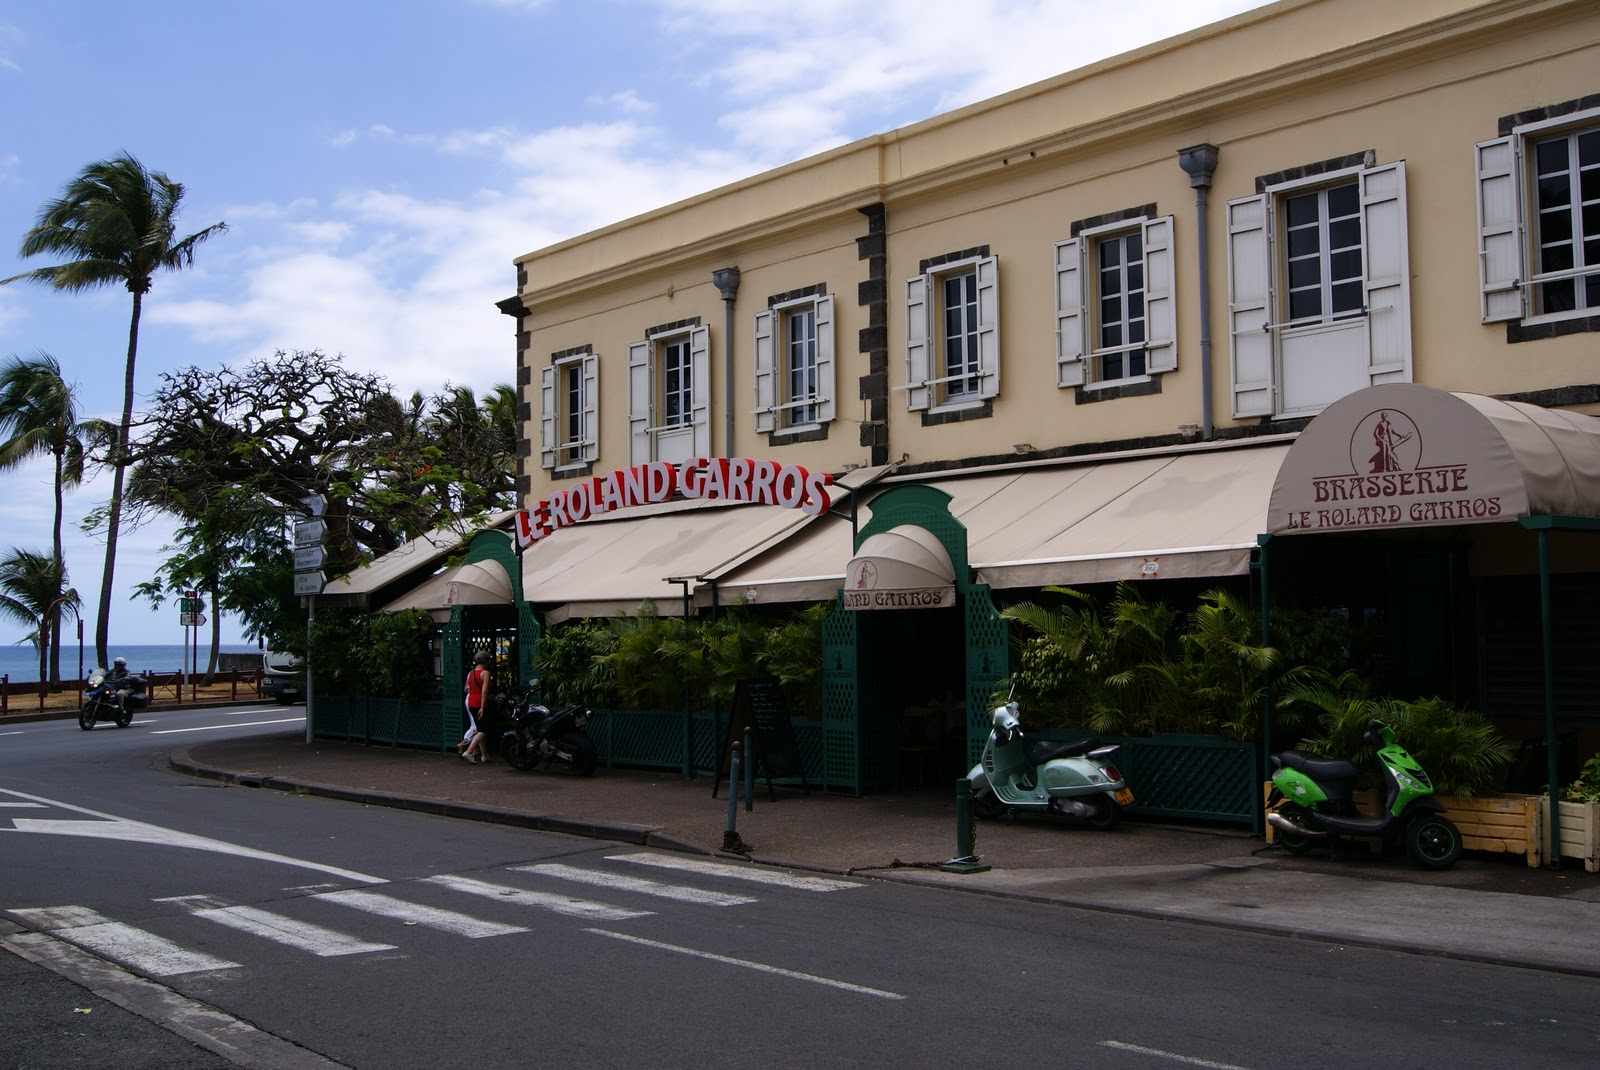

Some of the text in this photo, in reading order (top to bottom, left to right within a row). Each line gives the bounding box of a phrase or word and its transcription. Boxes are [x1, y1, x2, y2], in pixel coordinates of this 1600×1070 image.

[515, 457, 833, 548] LE ROLAND GARROS
[1312, 468, 1469, 503] BRASSERIE
[1287, 497, 1502, 530] LE ROLAND GARROS
[875, 591, 942, 607] GARROS
